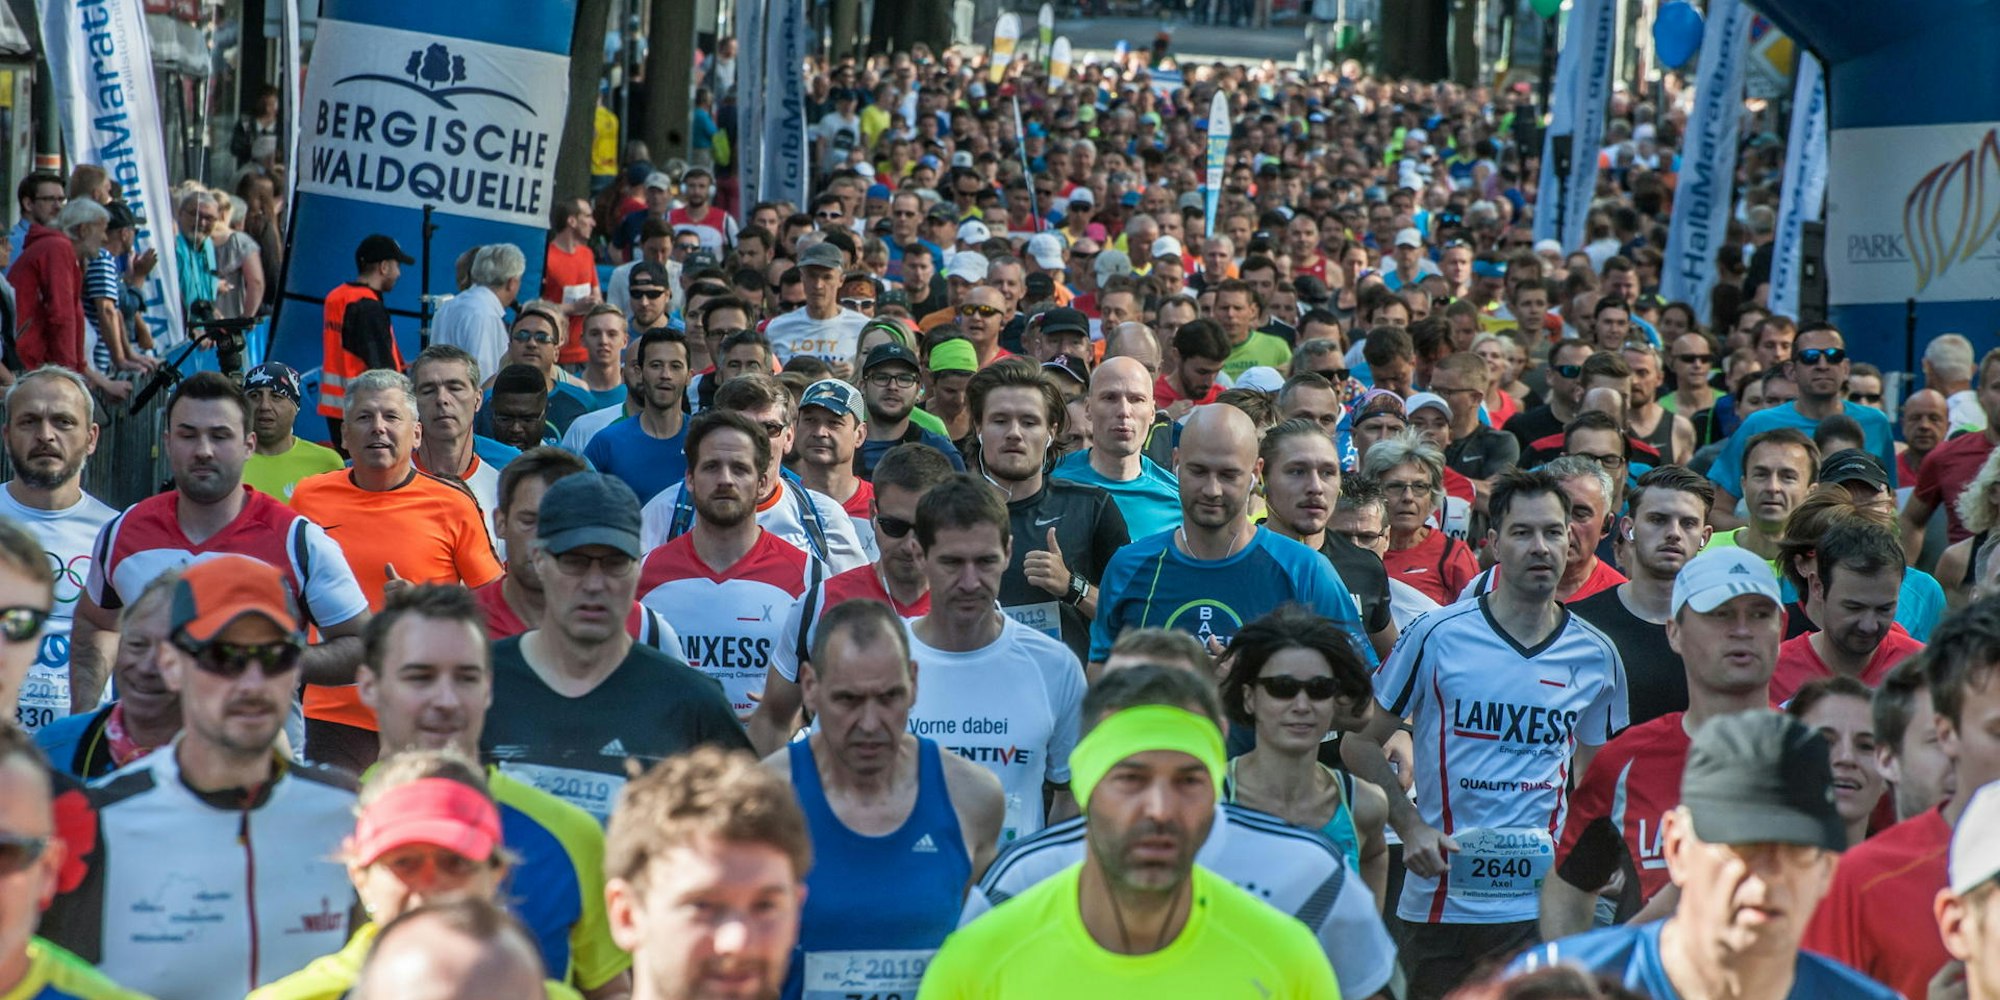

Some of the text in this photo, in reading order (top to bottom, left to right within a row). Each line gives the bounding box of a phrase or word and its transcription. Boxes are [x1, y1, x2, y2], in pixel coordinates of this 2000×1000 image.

[316, 99, 549, 169] BERGISCHE
[312, 145, 542, 215] WALDQUELLE
[1847, 233, 1904, 258] PARK
[791, 339, 838, 352] LOTT
[909, 717, 1008, 735] Vorne dabei
[1453, 698, 1578, 746] LANXESS
[551, 776, 609, 801] 2019
[1460, 778, 1518, 791] QUALITY
[1494, 833, 1539, 847] 2019
[1471, 858, 1532, 878] 2640
[1491, 880, 1513, 888] Axel
[865, 958, 925, 979] 2019
